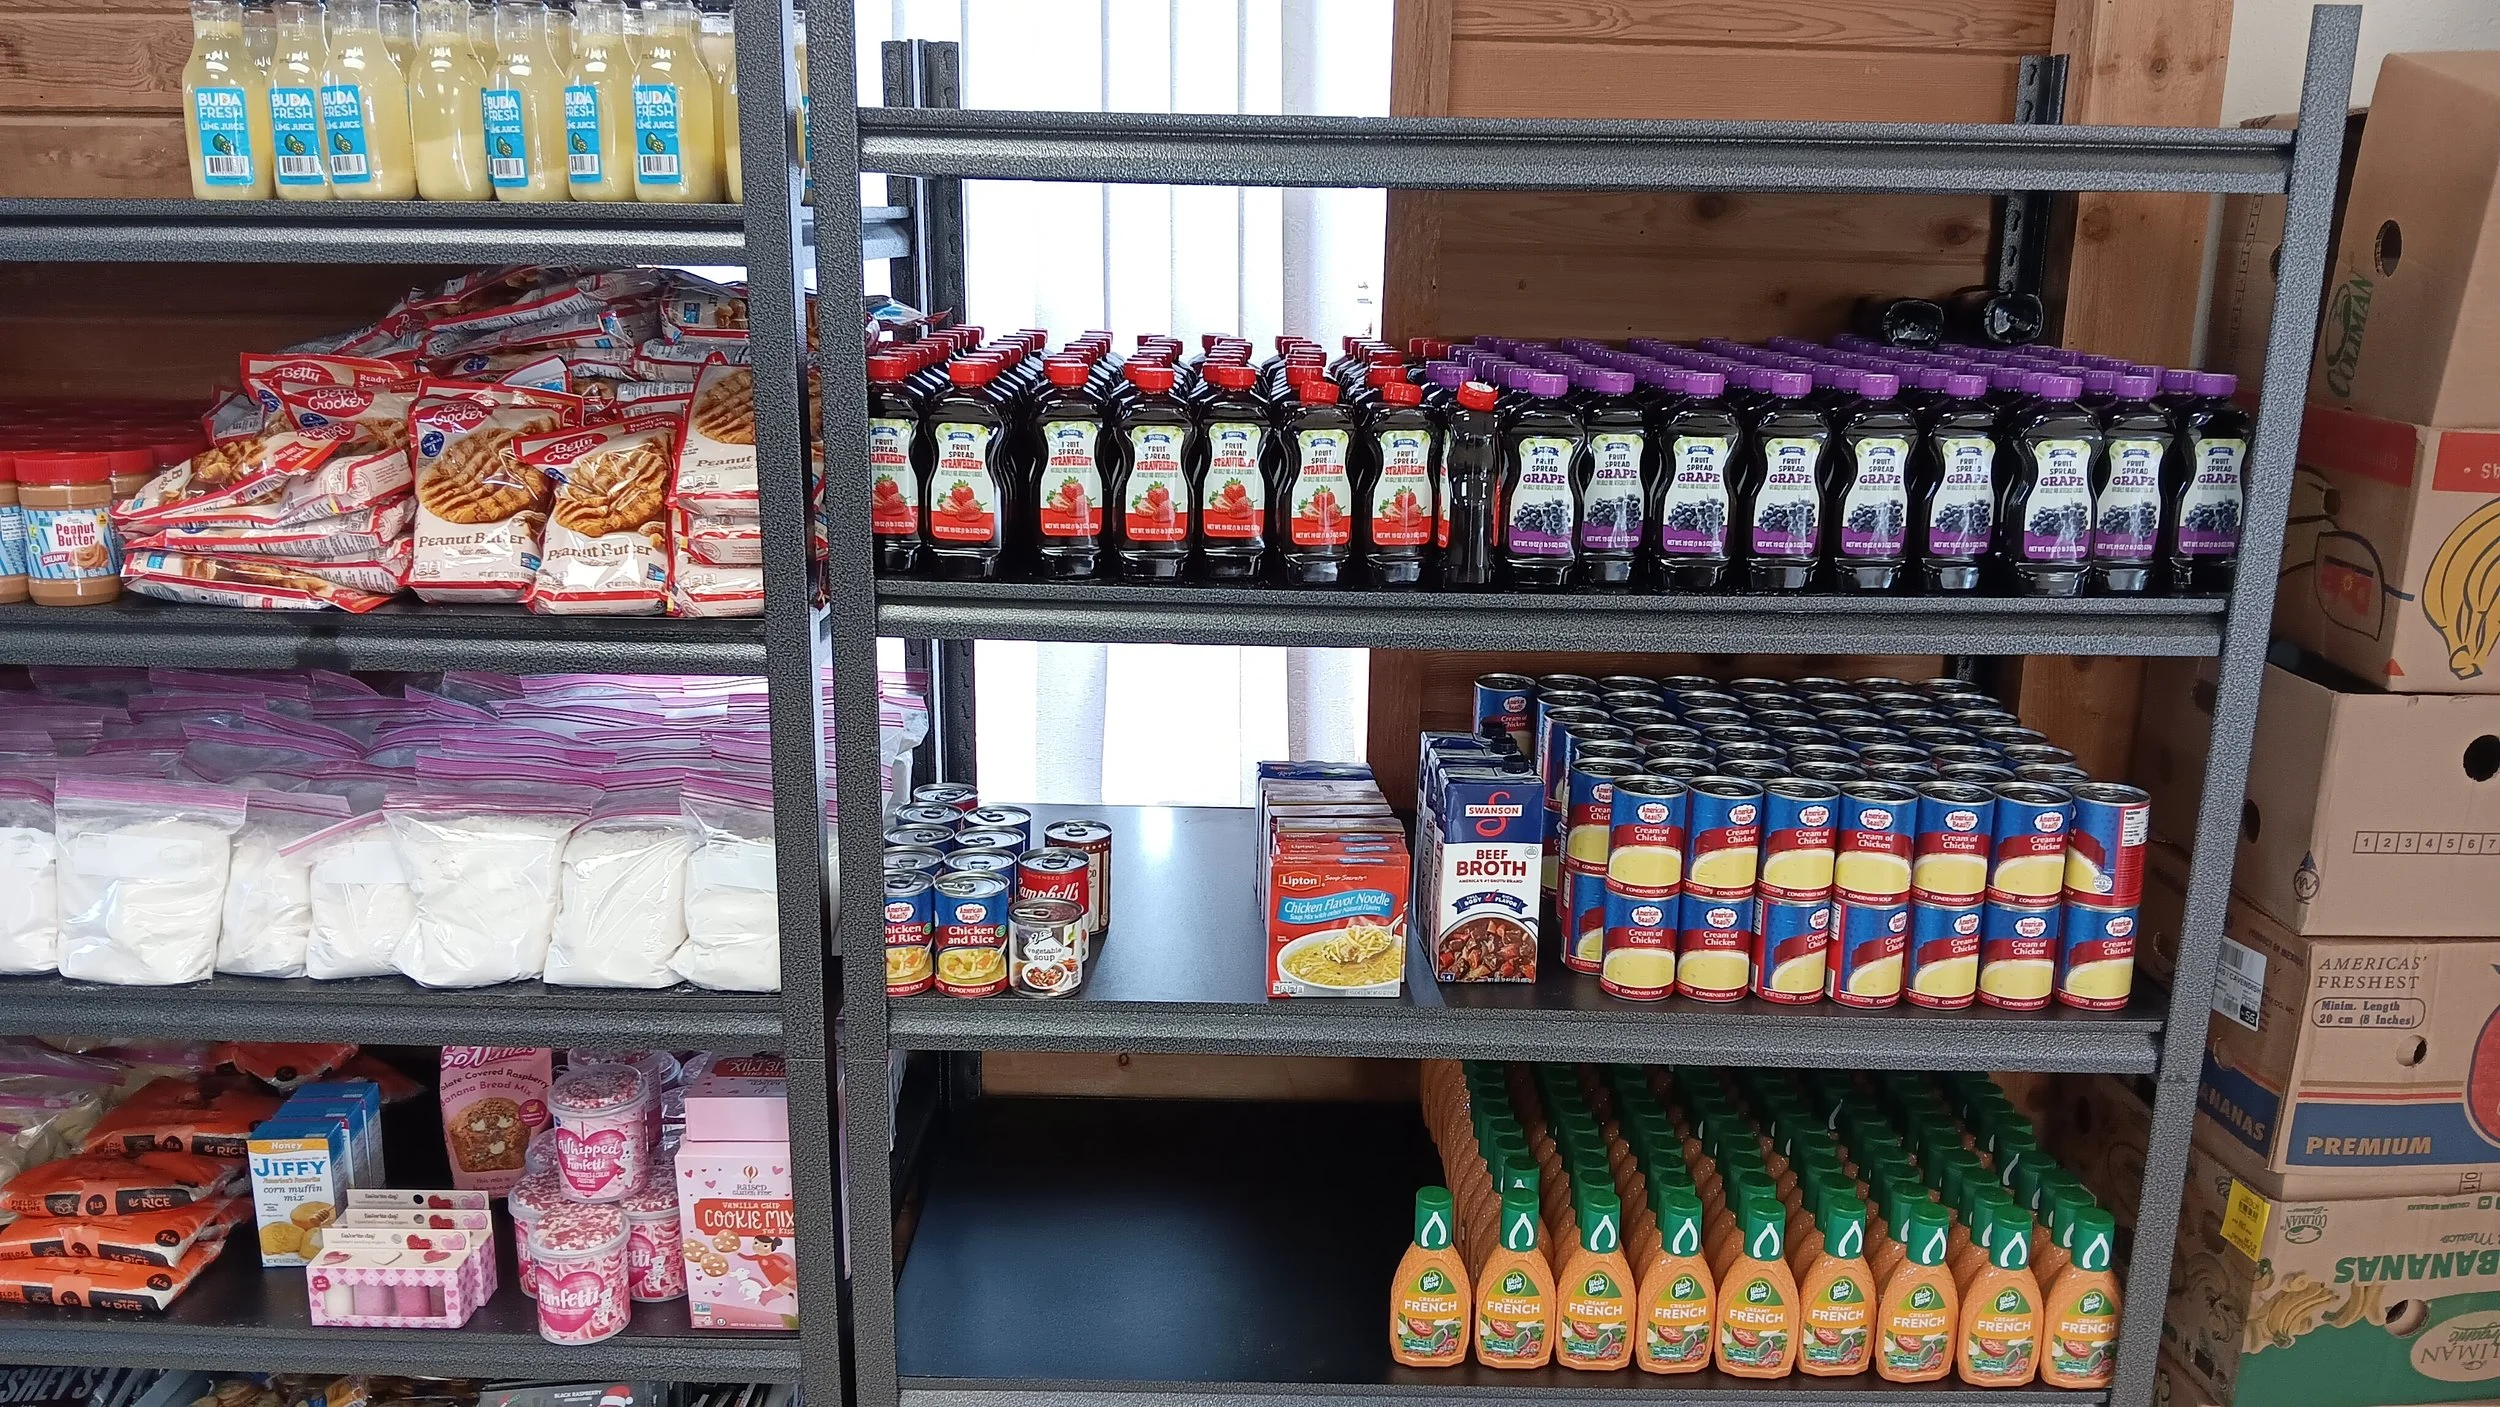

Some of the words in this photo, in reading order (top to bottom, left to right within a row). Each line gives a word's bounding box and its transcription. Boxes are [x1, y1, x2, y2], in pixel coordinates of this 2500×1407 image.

[198, 93, 242, 107] BUDA
[271, 93, 311, 107] BUDA
[321, 91, 357, 106] BUDA
[487, 95, 518, 109] BUDA
[565, 91, 594, 105] BUDA
[635, 91, 671, 105] BUDA
[200, 107, 243, 118] FRESH
[273, 107, 313, 119] FRESH
[324, 104, 358, 117] FRESH
[489, 109, 519, 121] FRESH
[565, 105, 595, 117] FRESH
[636, 104, 674, 117] FRESH
[220, 122, 245, 131] JUICE
[281, 366, 320, 383] Betty
[307, 395, 371, 411] Crocker
[554, 437, 594, 454] Betty
[948, 451, 974, 459] SPREAD
[1050, 456, 1092, 466] STRAWBERRY
[697, 455, 752, 468] Peanut
[1523, 474, 1565, 484] GRAPE
[1596, 469, 1637, 479] GRAPE
[1677, 473, 1720, 483] GRAPE
[1769, 474, 1812, 484] GRAPE
[1859, 474, 1901, 484] GRAPE
[2198, 474, 2238, 484] GRAPE
[2040, 477, 2084, 487] GRAPE
[2112, 477, 2155, 487] GRAPE
[56, 522, 95, 535] Peanut
[58, 535, 95, 547] Butter
[418, 533, 473, 547] Peanut
[1469, 807, 1519, 815] SWANSON
[1641, 806, 1666, 814] American
[1634, 826, 1660, 835] Cream
[1661, 827, 1670, 835] of
[1796, 830, 1821, 838] Cream
[1635, 834, 1667, 842] Chicken
[1797, 837, 1827, 845] Chicken
[1857, 832, 1883, 840] Cream
[1885, 834, 1894, 842] of
[1941, 834, 1969, 842] Cream
[1970, 835, 1978, 843] of
[1858, 840, 1891, 849] Chicken
[1943, 841, 1975, 850] Chicken
[2363, 838, 2369, 848] 1
[2383, 838, 2391, 848] 2
[2404, 838, 2412, 849] 3
[2425, 838, 2433, 849] 4
[2446, 838, 2455, 849] 5
[2467, 838, 2475, 849] 6
[2488, 838, 2496, 849] 7
[1476, 849, 1508, 859] BEEF
[1456, 861, 1527, 876] BROTH
[1282, 876, 1317, 887] Lipton
[1019, 880, 1079, 901] ampbell's
[1284, 901, 1322, 914] Chicken
[1324, 896, 1357, 911] Flavor
[1356, 892, 1390, 906] Noodle
[1464, 897, 1482, 906] BODY
[1495, 897, 1518, 908] FLAVOR
[1315, 911, 1327, 919] with
[1327, 909, 1341, 917] other
[885, 925, 921, 935] hicken
[948, 926, 994, 935] Chicken
[1628, 929, 1654, 937] Cream
[1655, 929, 1663, 937] of
[898, 934, 922, 942] Rice
[948, 936, 966, 944] and
[971, 935, 995, 944] Rice
[1630, 936, 1661, 944] Chicken
[2011, 940, 2037, 948] Cream
[2039, 940, 2046, 948] of
[1027, 947, 1062, 955] vegetable
[2013, 947, 2044, 955] Chicken
[1034, 954, 1055, 962] soup
[2318, 955, 2428, 971] AMERICAS'
[2229, 972, 2261, 994] CAVENDISH
[2316, 975, 2420, 989] FRESHEST
[2321, 1001, 2357, 1011] Minim.
[2363, 1001, 2400, 1013] Length
[2319, 1014, 2333, 1024] 20
[2338, 1016, 2353, 1024] cm
[2359, 1014, 2370, 1026] (8
[2375, 1014, 2416, 1026] Inches)
[465, 1067, 504, 1080] Covered
[506, 1068, 549, 1089] Raspberry
[480, 1081, 511, 1089] Bread
[514, 1083, 532, 1097] Mix
[216, 1145, 246, 1156] RICE
[271, 1142, 303, 1150] Honey
[558, 1137, 620, 1158] Whipped
[2305, 1136, 2432, 1156] PREMIUM
[253, 1158, 326, 1177] JIFFY
[567, 1157, 606, 1171] Funfetti
[263, 1186, 285, 1194] corn
[288, 1183, 323, 1194] muffin
[142, 1196, 171, 1209] RICE
[284, 1194, 304, 1202] mix
[704, 1209, 762, 1230] COOKIE
[765, 1209, 795, 1228] MIX
[2285, 1213, 2328, 1228] COLIMAN
[2440, 1232, 2493, 1245] Mexico
[2334, 1250, 2500, 1284] BANANAS
[538, 1284, 601, 1306] Funfetti
[1404, 1300, 1457, 1312] FRENCH
[1487, 1301, 1540, 1314] FRENCH
[1569, 1303, 1622, 1316] FRENCH
[1655, 1306, 1706, 1319] FRENCH
[1729, 1309, 1784, 1323] FRENCH
[1812, 1309, 1864, 1321] FRENCH
[1893, 1316, 1945, 1328] FRENCH
[1977, 1320, 2031, 1332] FRENCH
[2061, 1321, 2114, 1334] FRENCH
